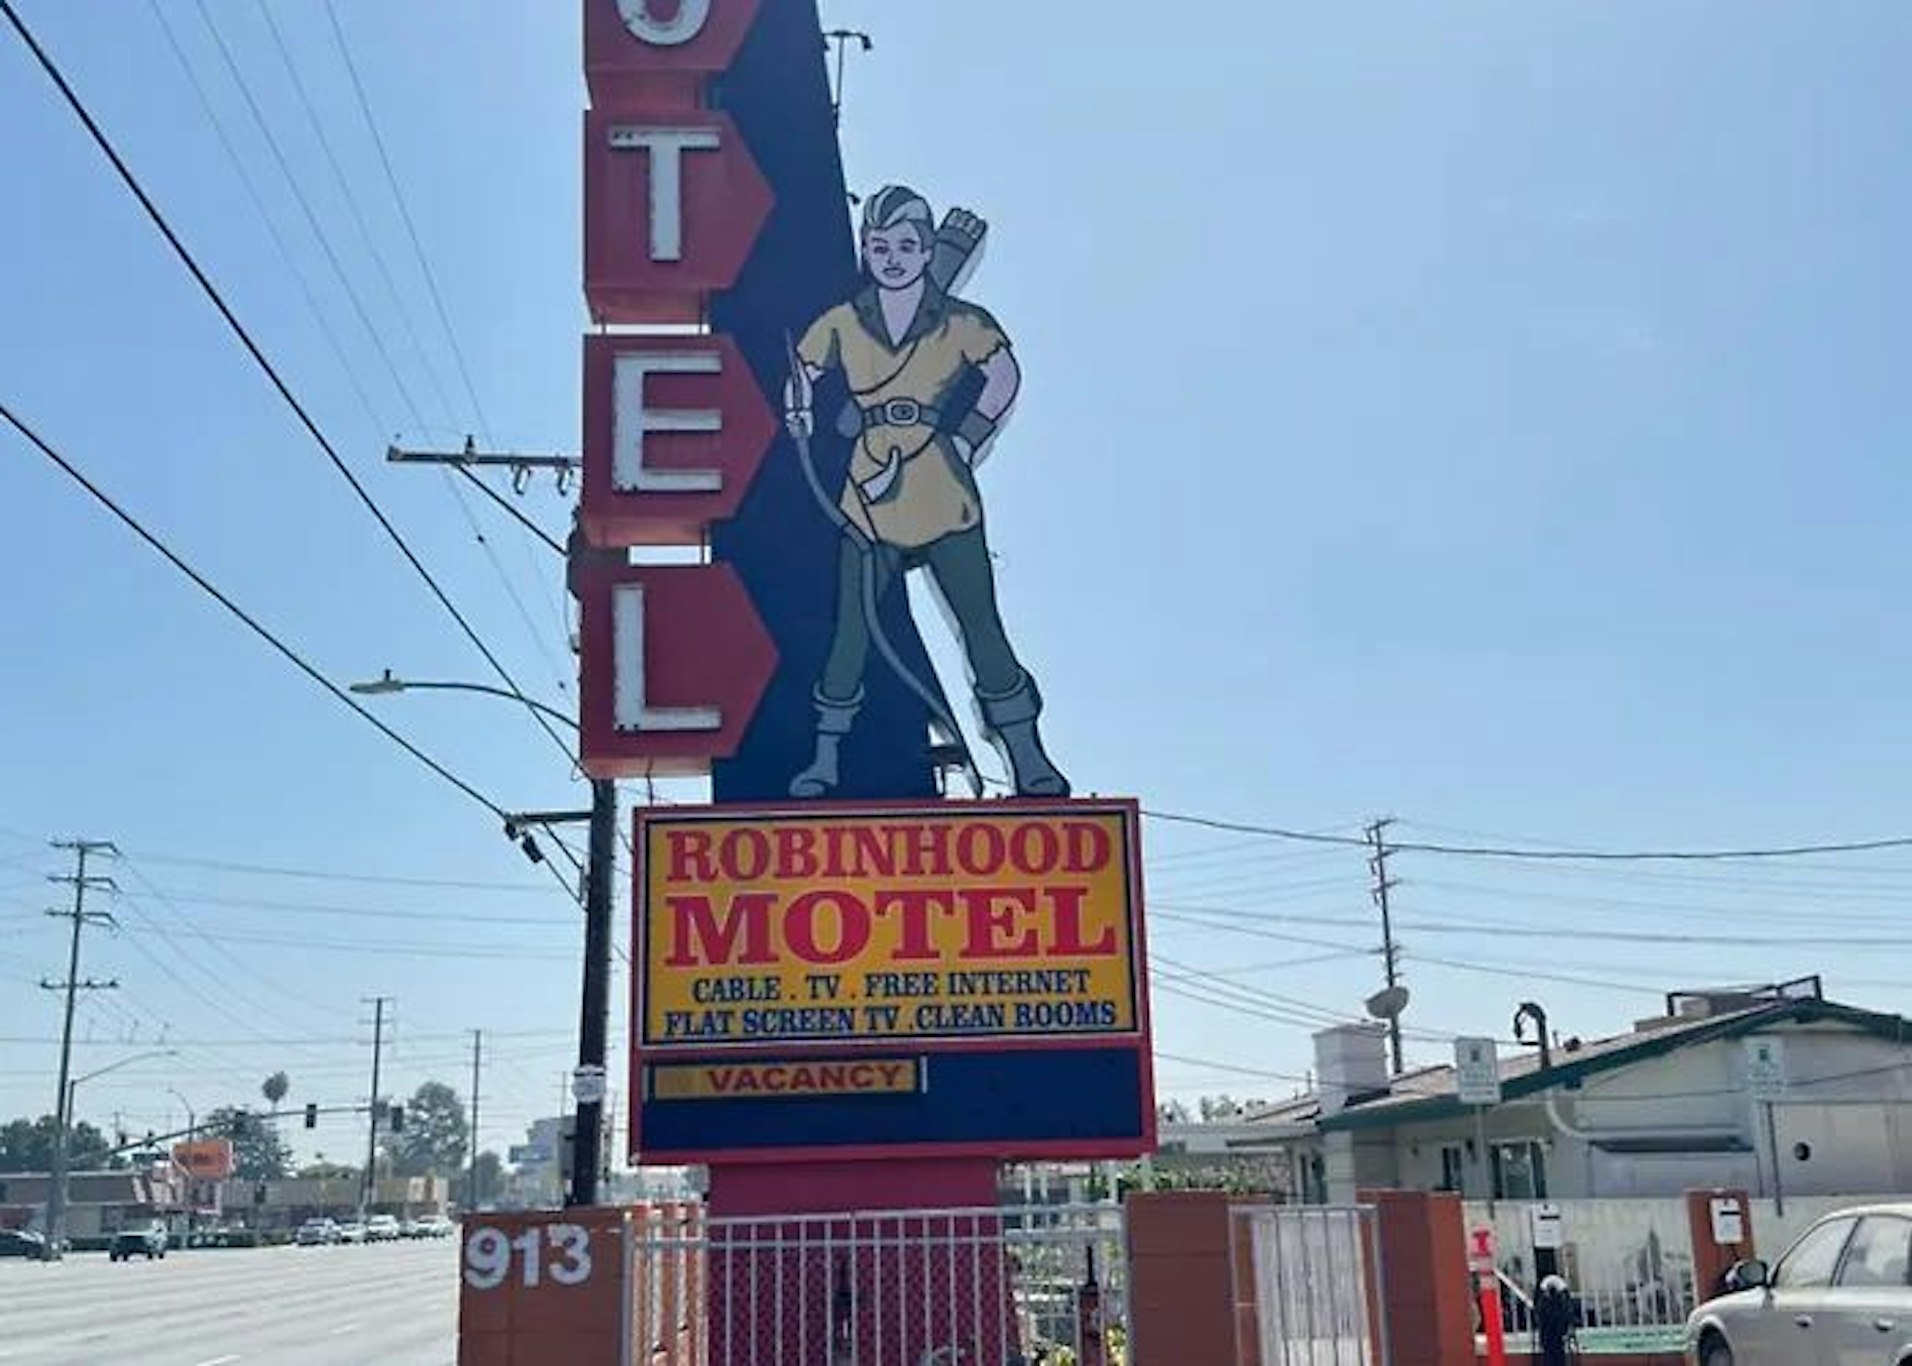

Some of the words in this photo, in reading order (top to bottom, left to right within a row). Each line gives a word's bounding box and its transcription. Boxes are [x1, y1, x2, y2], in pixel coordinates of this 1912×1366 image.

[665, 822, 1112, 883] ROBINHOOD
[664, 887, 1118, 968] MOTEL
[692, 975, 781, 1003] CABLE
[805, 974, 841, 1000] TV
[864, 971, 939, 997] FREE
[948, 969, 1090, 995] INTERNET
[664, 1009, 735, 1036] FLAT
[742, 1005, 856, 1034] SCREEN
[864, 1004, 900, 1031] TV
[1013, 1000, 1118, 1028] ROOMS
[707, 1064, 903, 1093] VACANCY
[464, 1222, 592, 1289] 913
